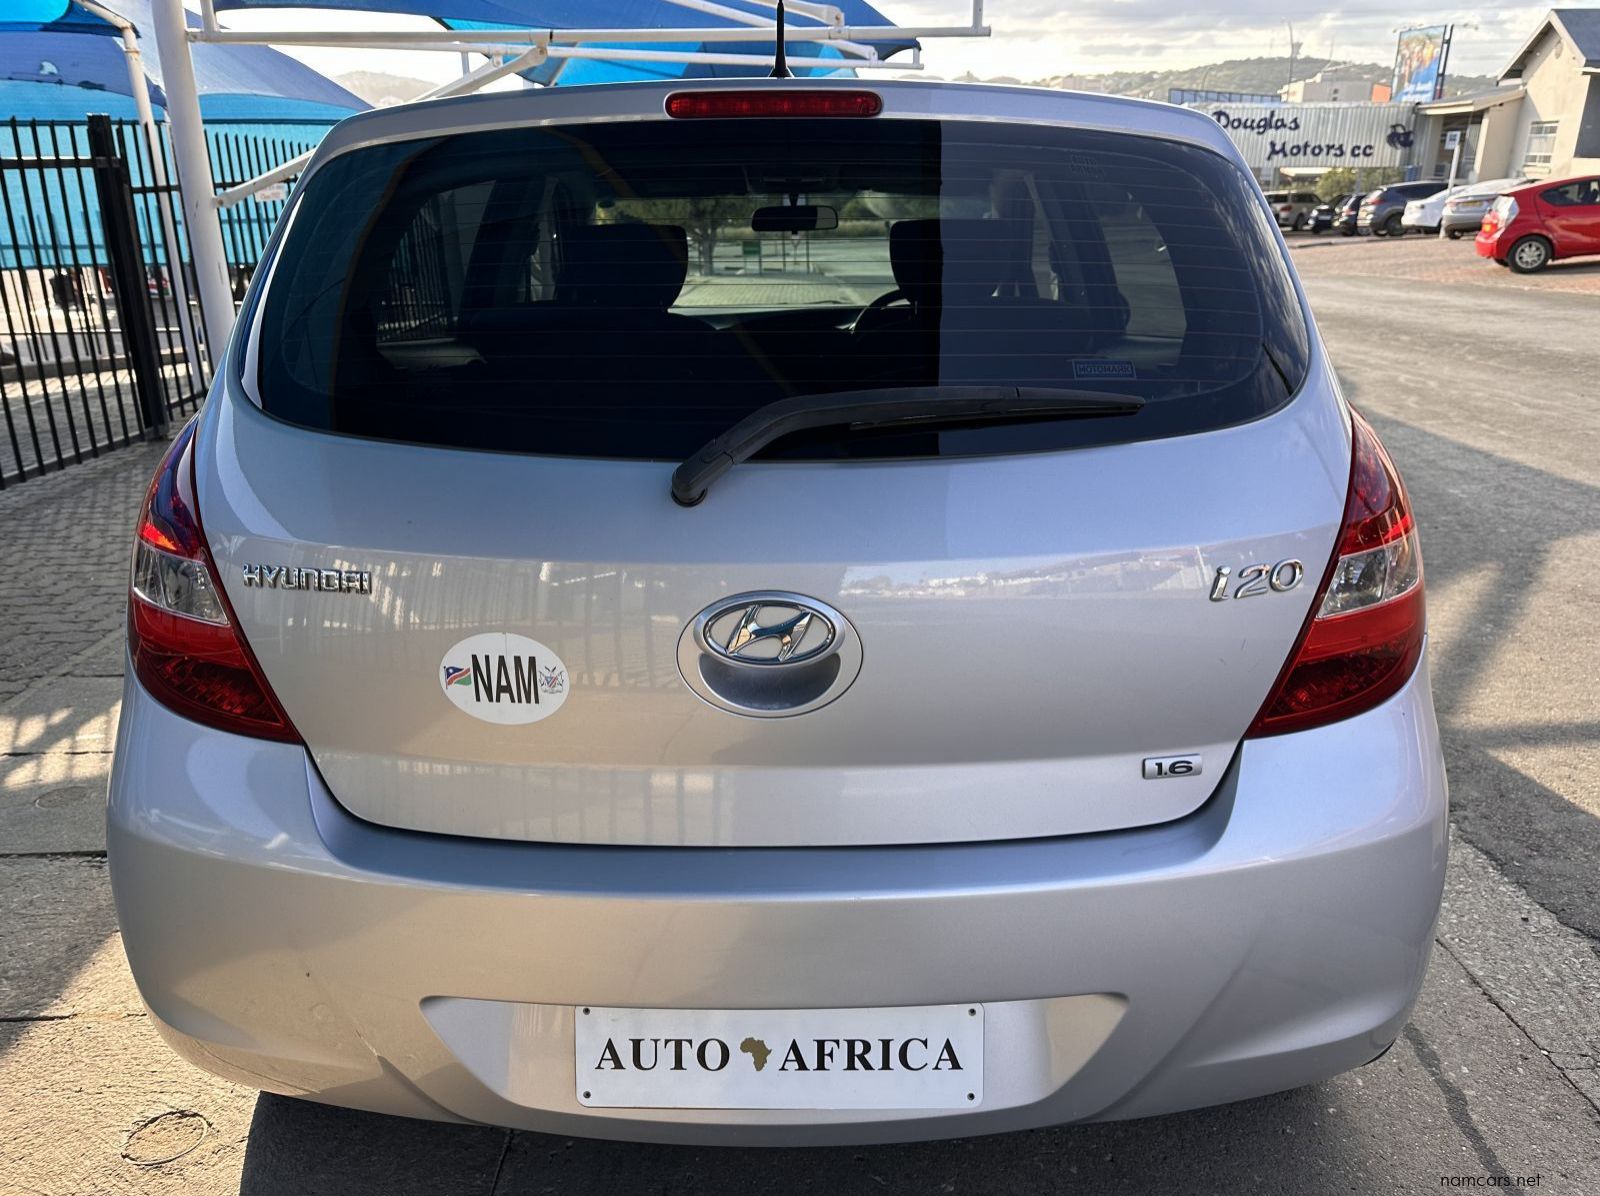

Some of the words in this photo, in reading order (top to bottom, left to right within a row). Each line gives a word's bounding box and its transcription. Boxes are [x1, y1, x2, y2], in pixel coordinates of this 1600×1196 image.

[1212, 110, 1300, 135] Douglas
[1267, 140, 1345, 160] Motors
[1350, 144, 1374, 157] cc
[242, 563, 372, 594] HYUNDAI
[1209, 559, 1304, 602] i20
[471, 653, 540, 705] NAM
[1155, 760, 1193, 776] 1.6
[595, 1037, 731, 1072] AUTO
[778, 1037, 963, 1072] AFRICA
